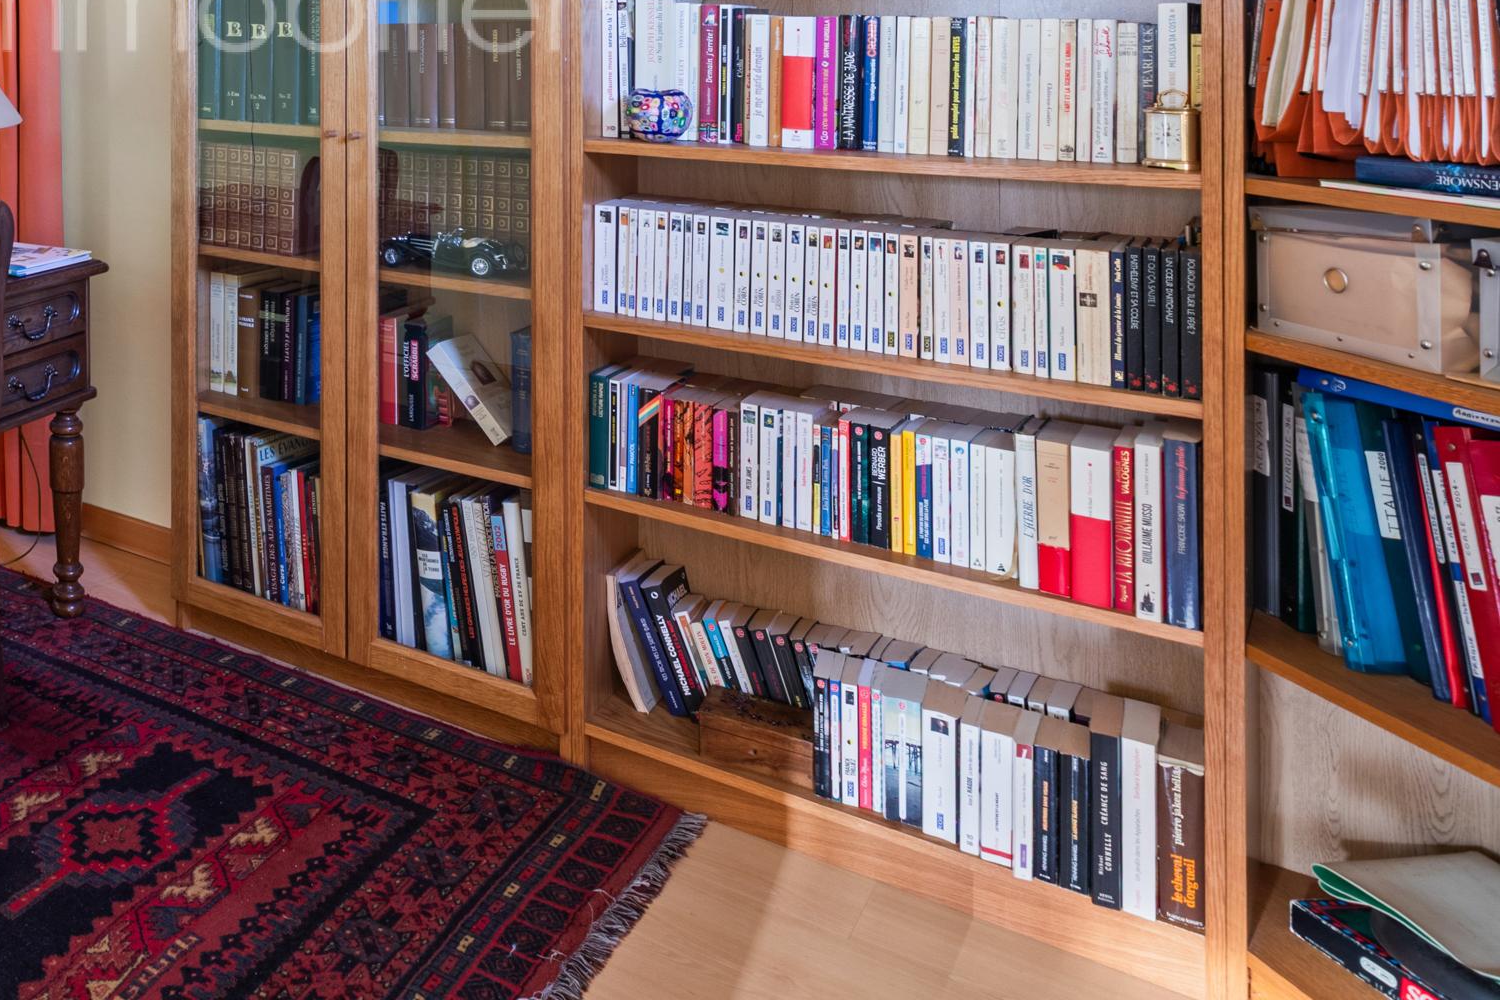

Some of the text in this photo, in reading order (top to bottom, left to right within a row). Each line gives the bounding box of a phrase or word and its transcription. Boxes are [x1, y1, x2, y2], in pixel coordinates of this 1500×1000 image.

[1142, 56, 1154, 88] PEARL
[877, 446, 886, 480] WERBER
[264, 475, 278, 595] VISAGES DES ALPES MARITIMES
[493, 525, 502, 550] 2002
[1141, 503, 1153, 564] GUILLAUME MUSSO
[499, 563, 516, 646] LE LIVRE D'OR DU RUGBY
[655, 614, 692, 697] MICHAEL CONNELLY
[1099, 761, 1108, 825] CRÉANCE DE SANG
[1172, 817, 1184, 846] pierre
[1103, 833, 1112, 871] CONNELLY
[1170, 854, 1183, 892] cheval
